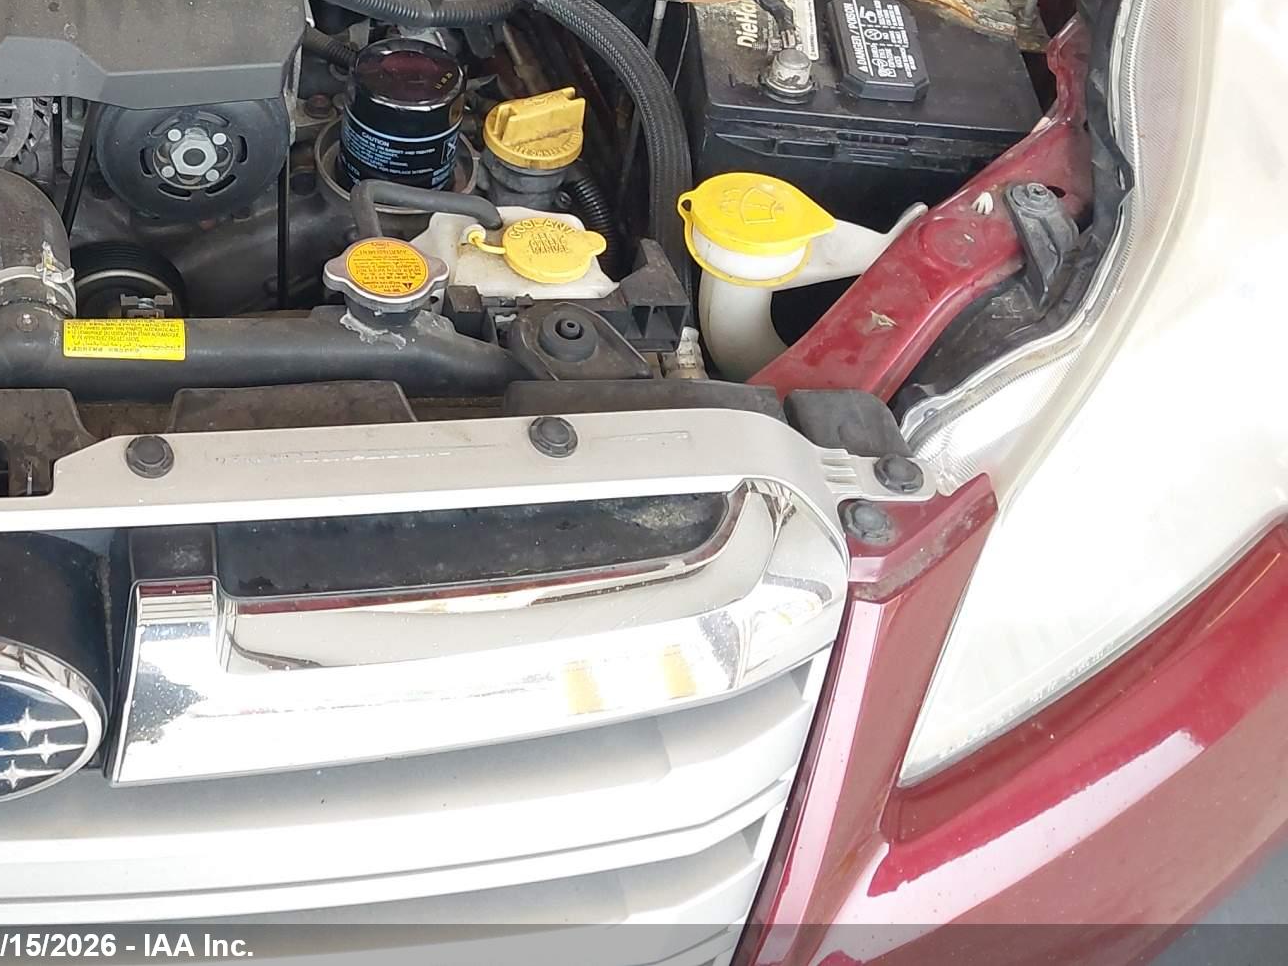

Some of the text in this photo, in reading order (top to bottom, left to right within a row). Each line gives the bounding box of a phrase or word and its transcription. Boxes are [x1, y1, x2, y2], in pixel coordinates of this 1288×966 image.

[843, 2, 859, 30] POISON
[850, 35, 868, 66] DANGER
[361, 131, 390, 148] CAUTION
[509, 218, 576, 240] COOLANT
